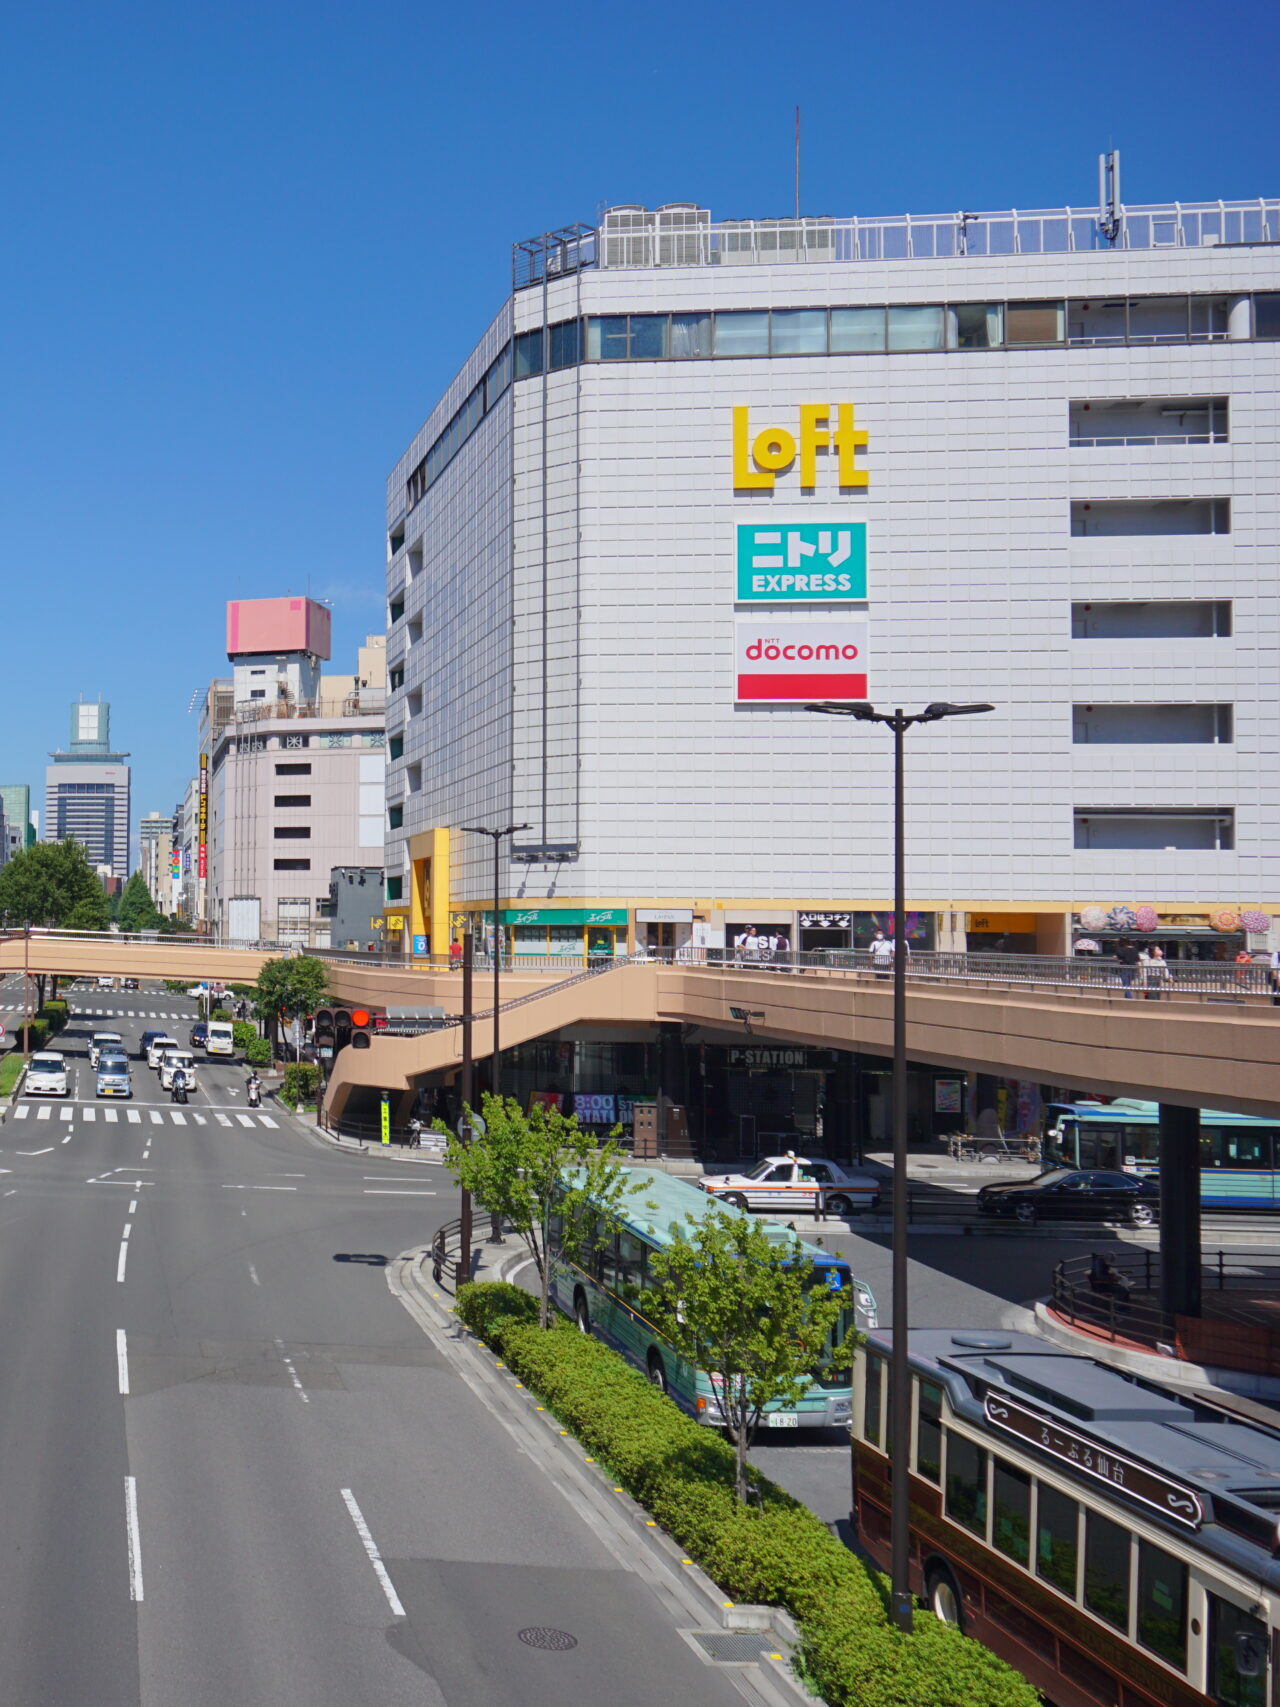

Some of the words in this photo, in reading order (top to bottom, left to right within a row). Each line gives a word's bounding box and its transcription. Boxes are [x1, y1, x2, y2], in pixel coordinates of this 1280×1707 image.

[752, 530, 852, 568] ニトリ
[752, 573, 852, 593] EXPRESS
[745, 638, 859, 661] docomo
[513, 910, 541, 924] エイブル
[586, 910, 614, 923] エイブル
[800, 913, 851, 922] 入口はコチラ
[731, 1050, 804, 1065] P-STATION
[575, 1096, 614, 1110] 8:00
[1040, 1427, 1126, 1485] るーぷる仙台
